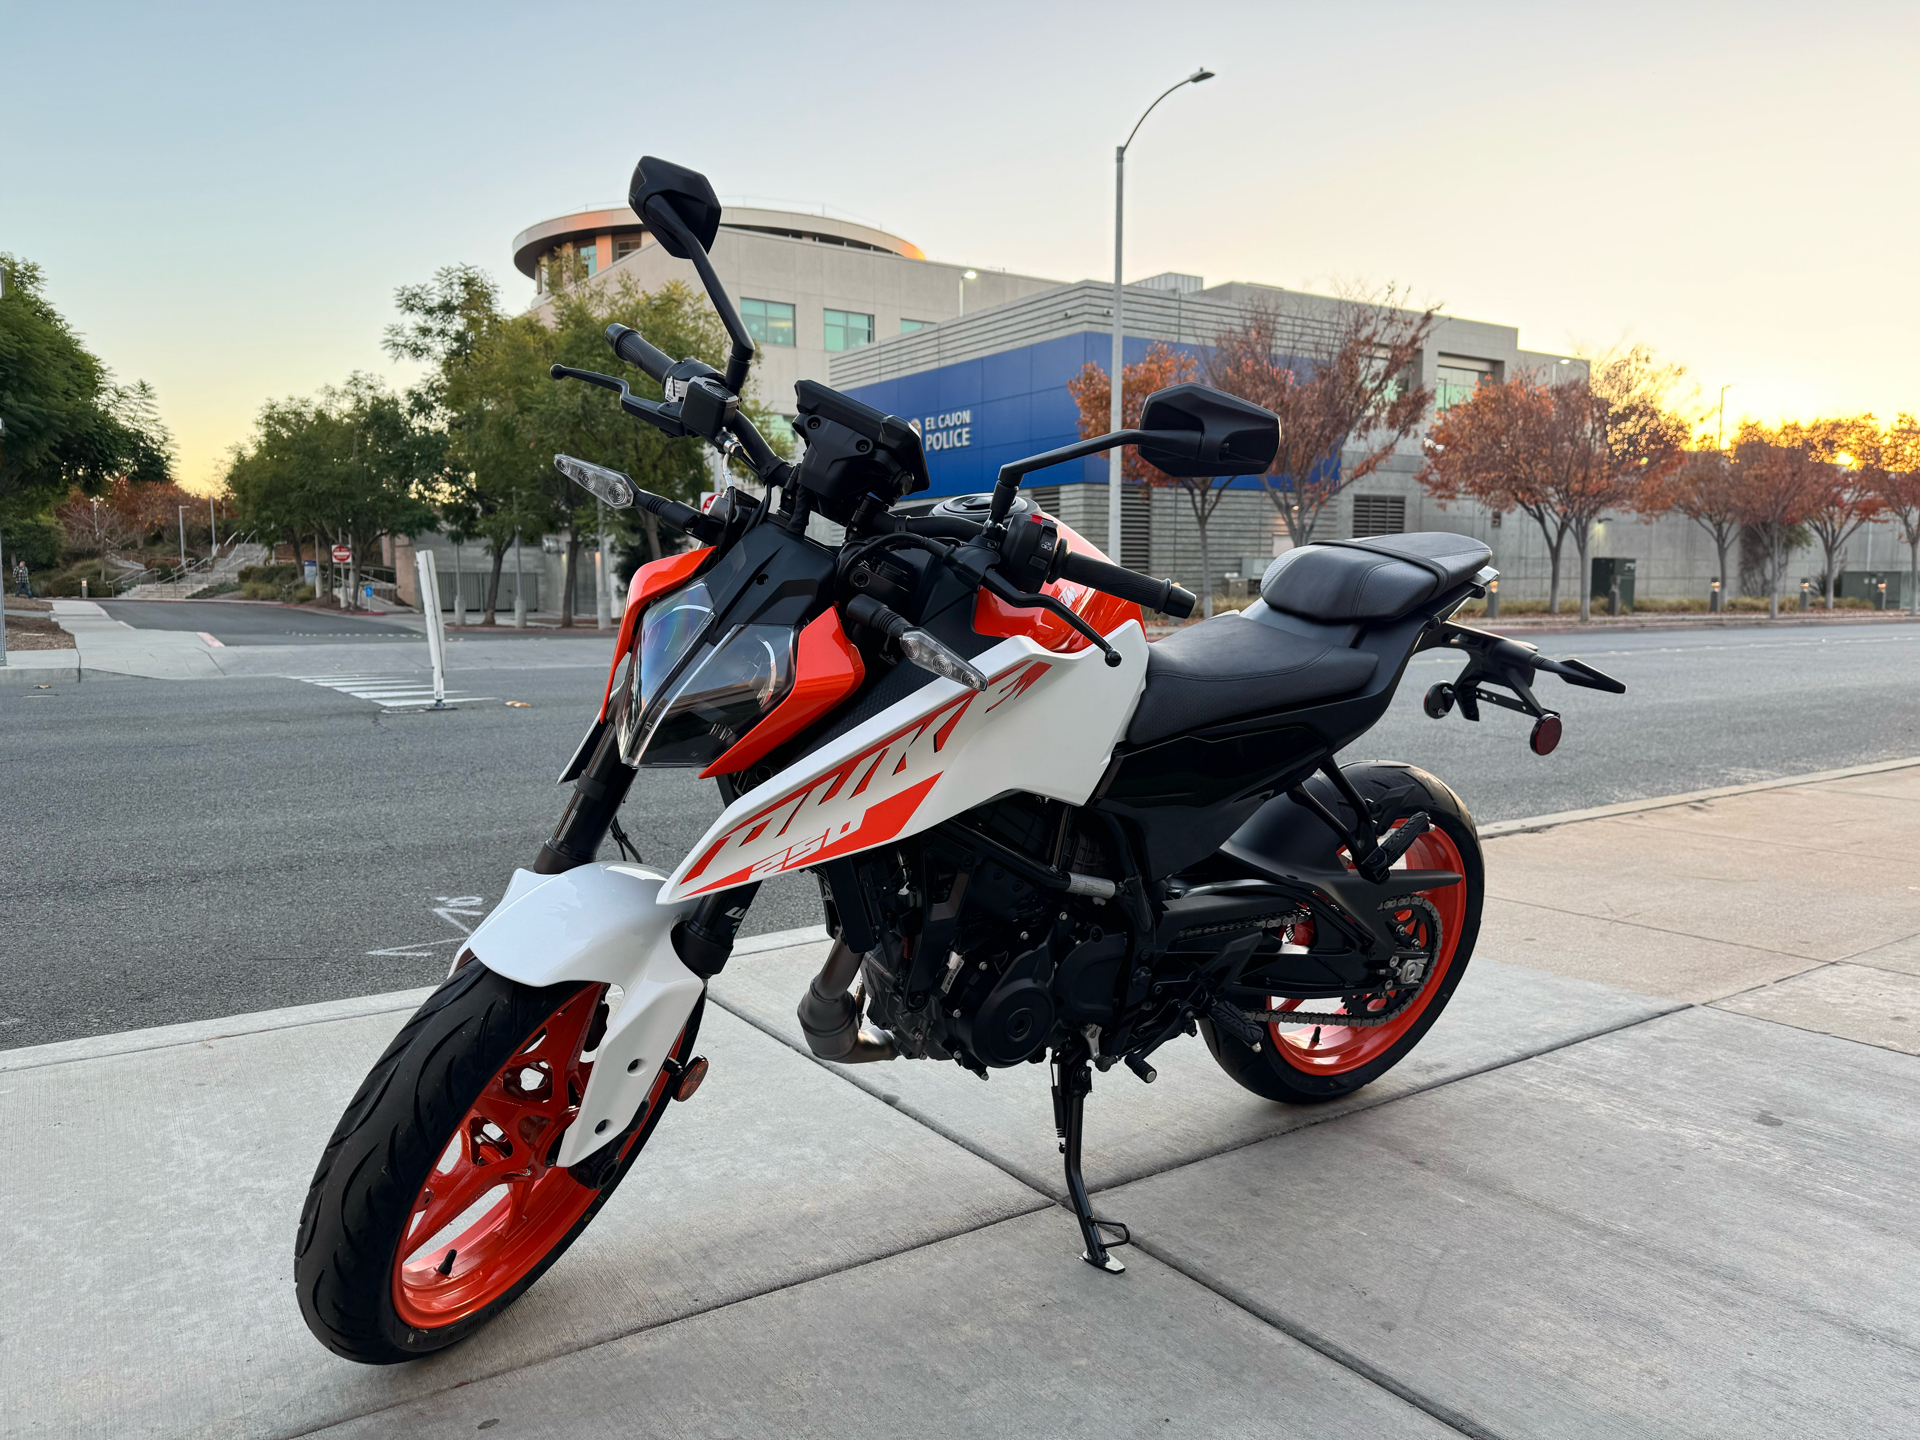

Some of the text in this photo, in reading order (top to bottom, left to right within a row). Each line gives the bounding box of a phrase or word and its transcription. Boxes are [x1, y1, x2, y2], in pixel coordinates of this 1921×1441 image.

[925, 409, 971, 431] EL CAJON
[925, 427, 971, 452] POLICE
[748, 809, 867, 881] 250
